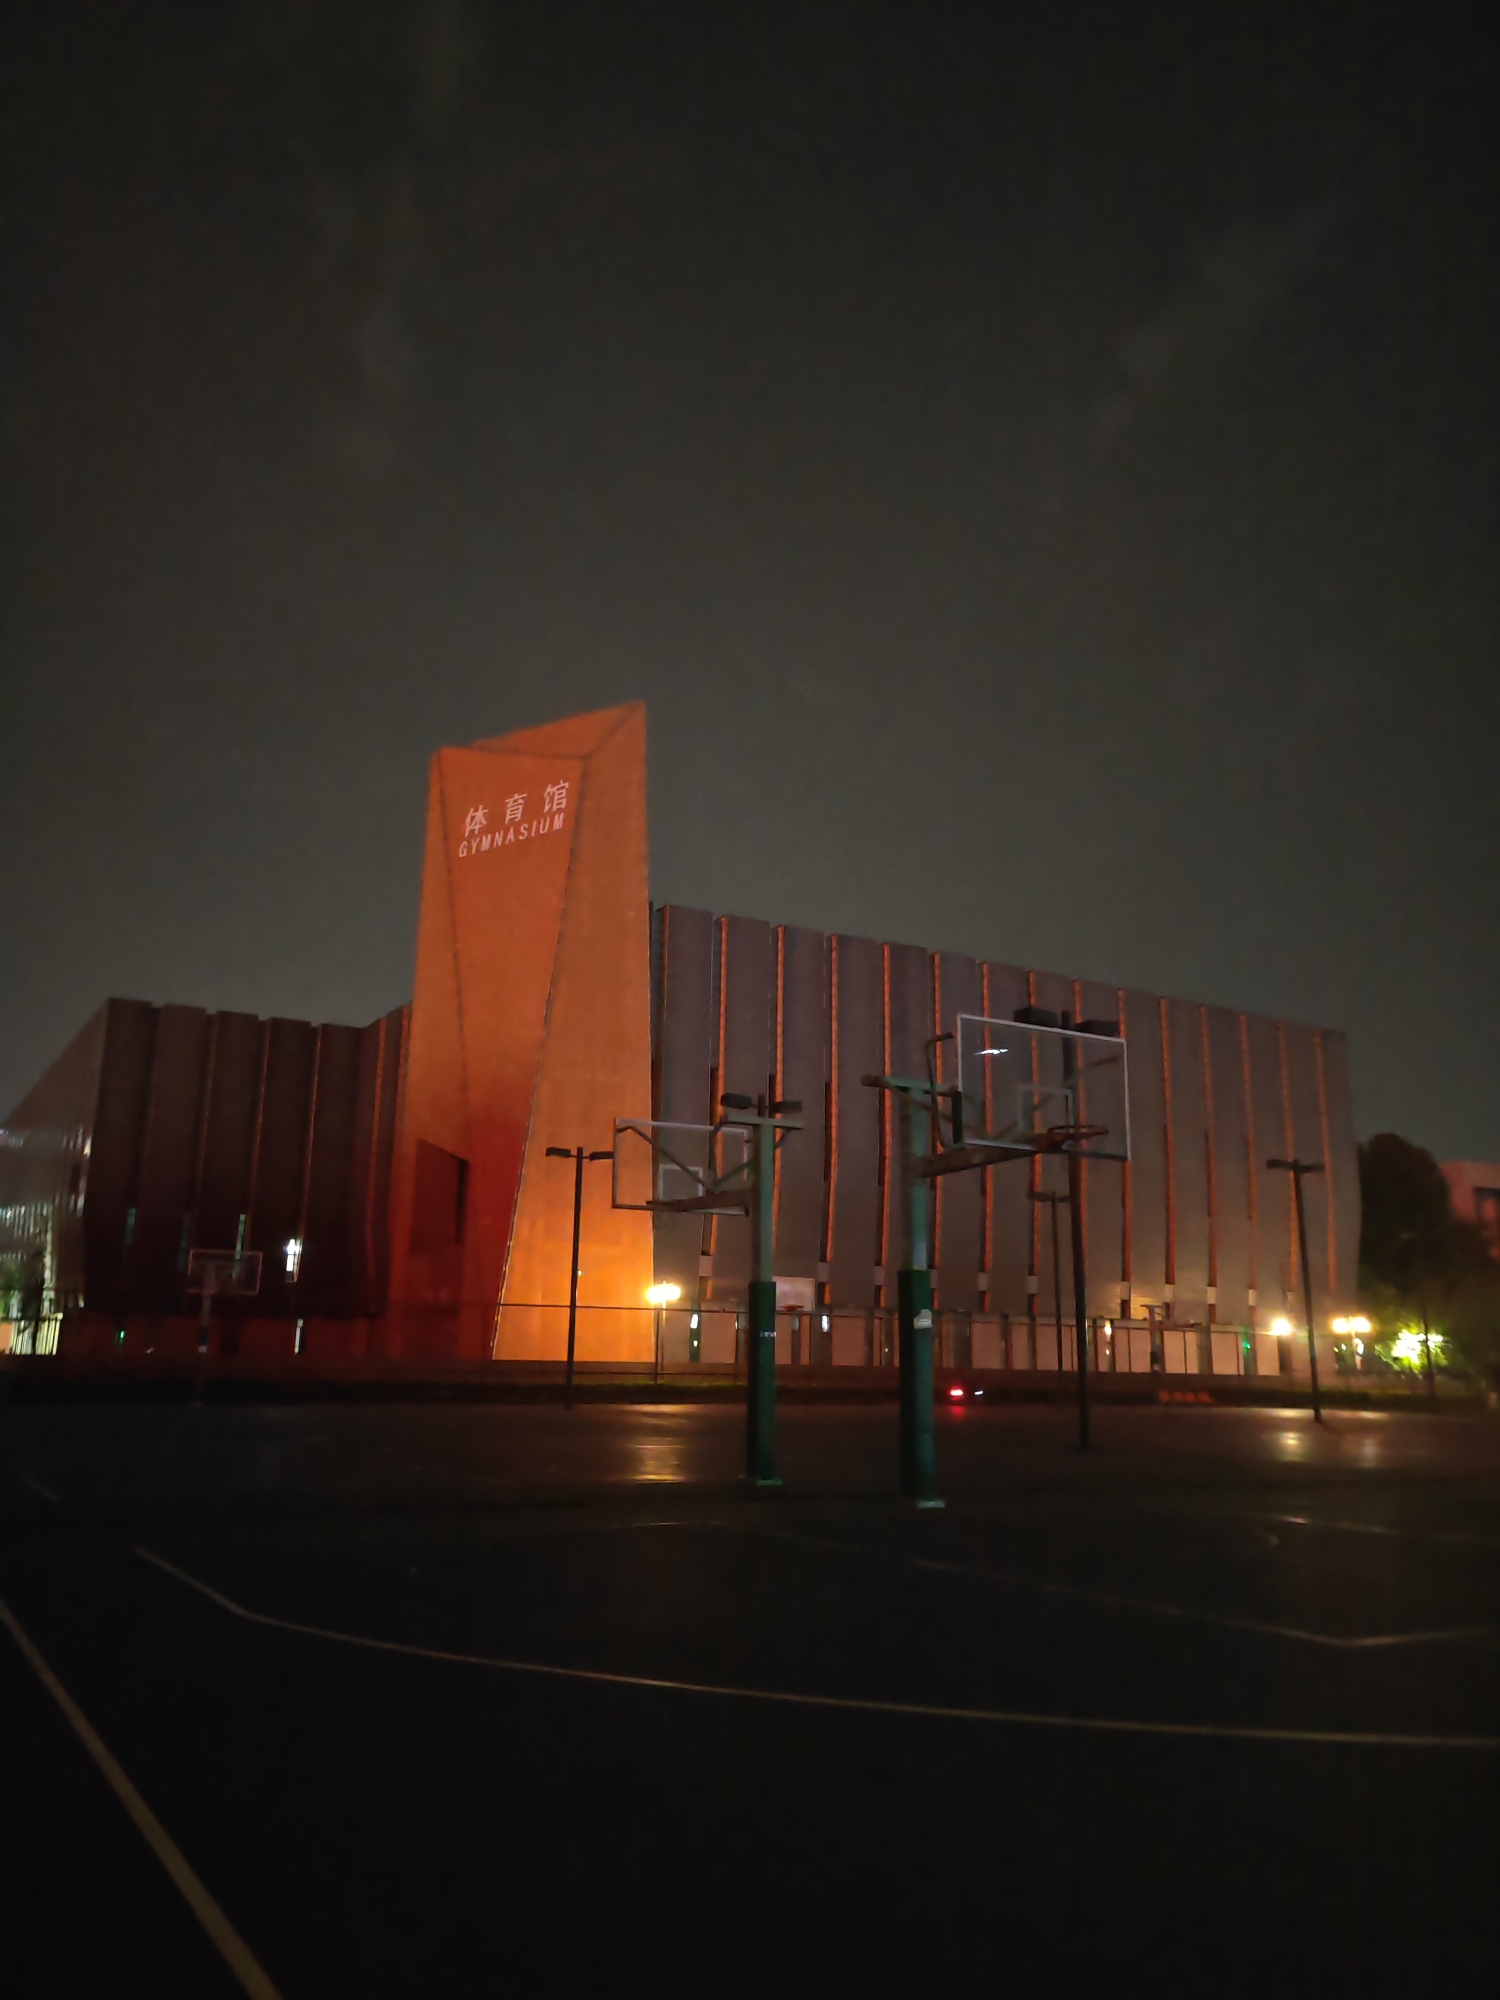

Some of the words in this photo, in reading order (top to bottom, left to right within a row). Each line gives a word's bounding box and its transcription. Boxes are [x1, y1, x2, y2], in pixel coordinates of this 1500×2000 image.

[464, 779, 569, 838] 体育馆
[458, 812, 564, 858] GYMNASIUM
